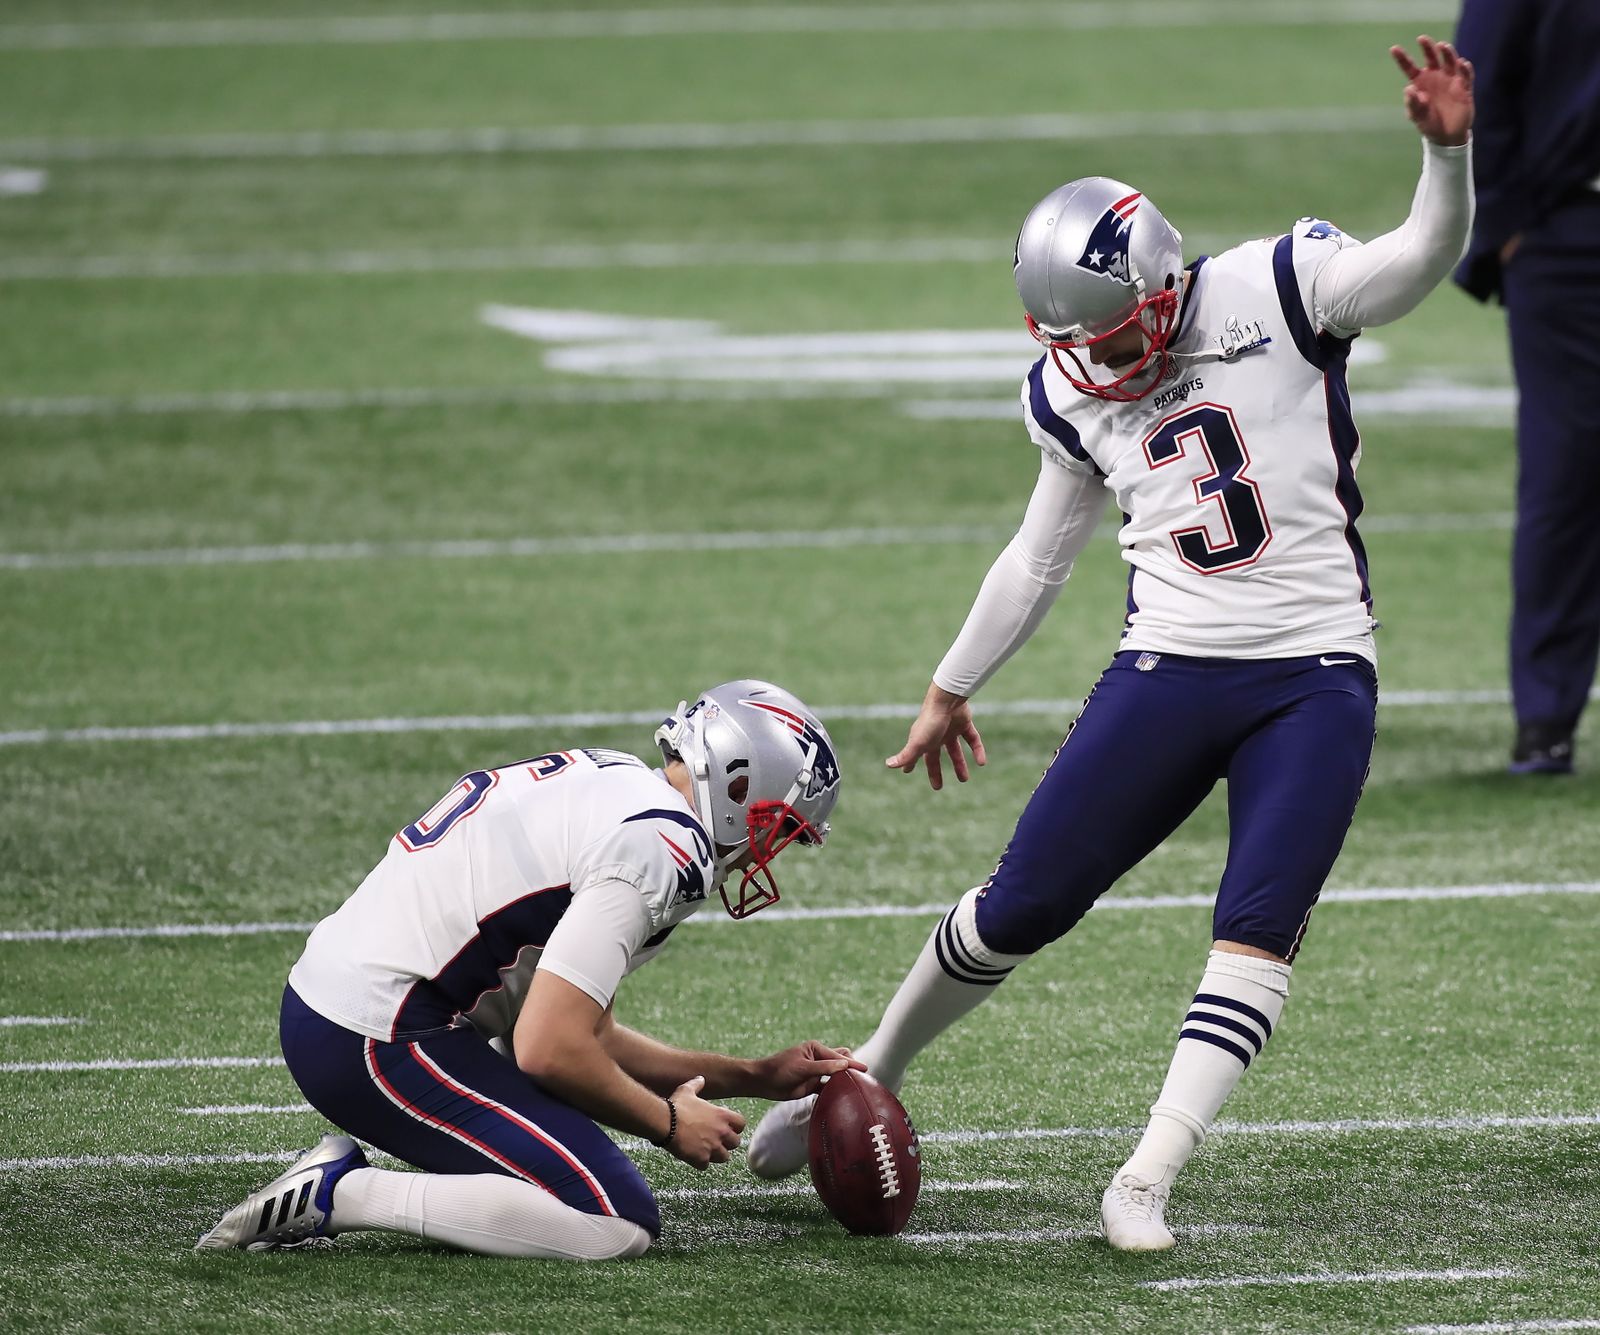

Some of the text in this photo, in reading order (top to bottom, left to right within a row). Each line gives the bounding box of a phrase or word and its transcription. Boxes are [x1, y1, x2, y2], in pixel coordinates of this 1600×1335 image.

[1153, 377, 1204, 410] PATRIOTS
[1142, 401, 1273, 575] 3
[685, 700, 706, 719] 6
